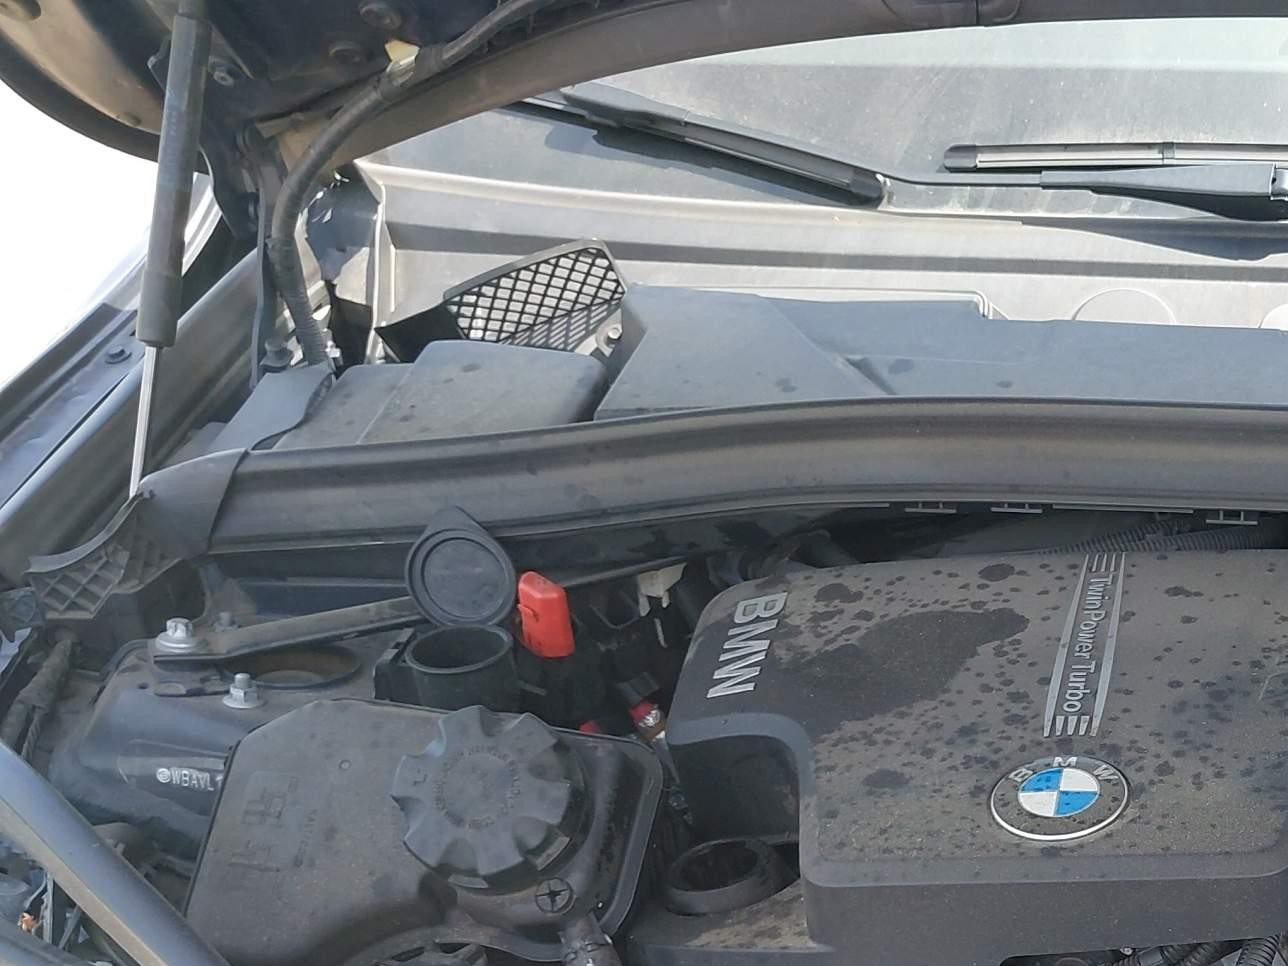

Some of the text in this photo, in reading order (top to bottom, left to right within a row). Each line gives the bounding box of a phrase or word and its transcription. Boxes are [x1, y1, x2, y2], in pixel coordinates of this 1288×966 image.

[706, 592, 788, 698] BMW
[1063, 572, 1116, 713] TwinPower Turbo
[1009, 756, 1119, 782] BMW
